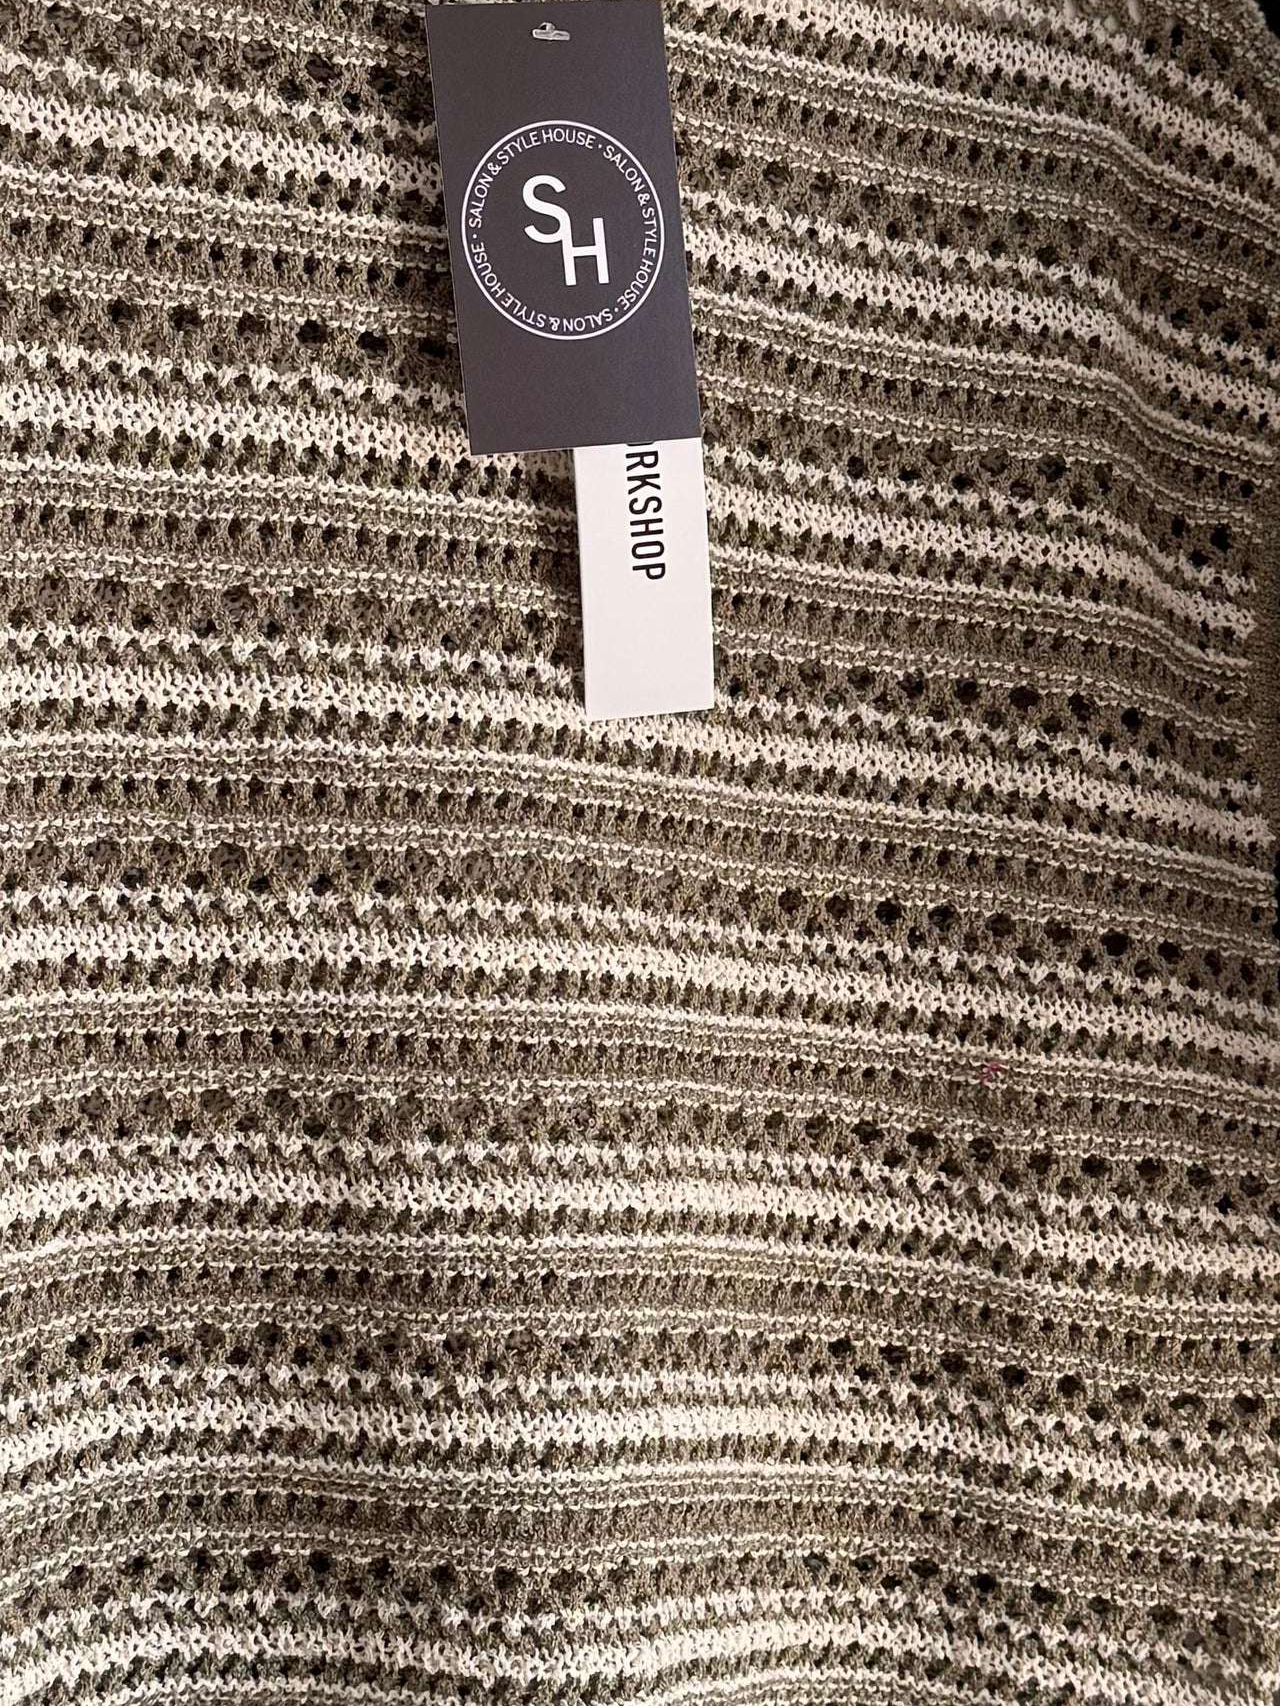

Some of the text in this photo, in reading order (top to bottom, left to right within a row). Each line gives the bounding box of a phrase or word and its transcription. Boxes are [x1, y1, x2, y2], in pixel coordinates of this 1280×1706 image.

[469, 128, 596, 229] SALON & STYLE HOUSE
[522, 174, 610, 286] SH
[602, 144, 658, 311] SALON & STYLE HOUSE
[470, 242, 614, 332] SALON & STYLE HOUSE
[625, 441, 666, 580] RKSHOP
